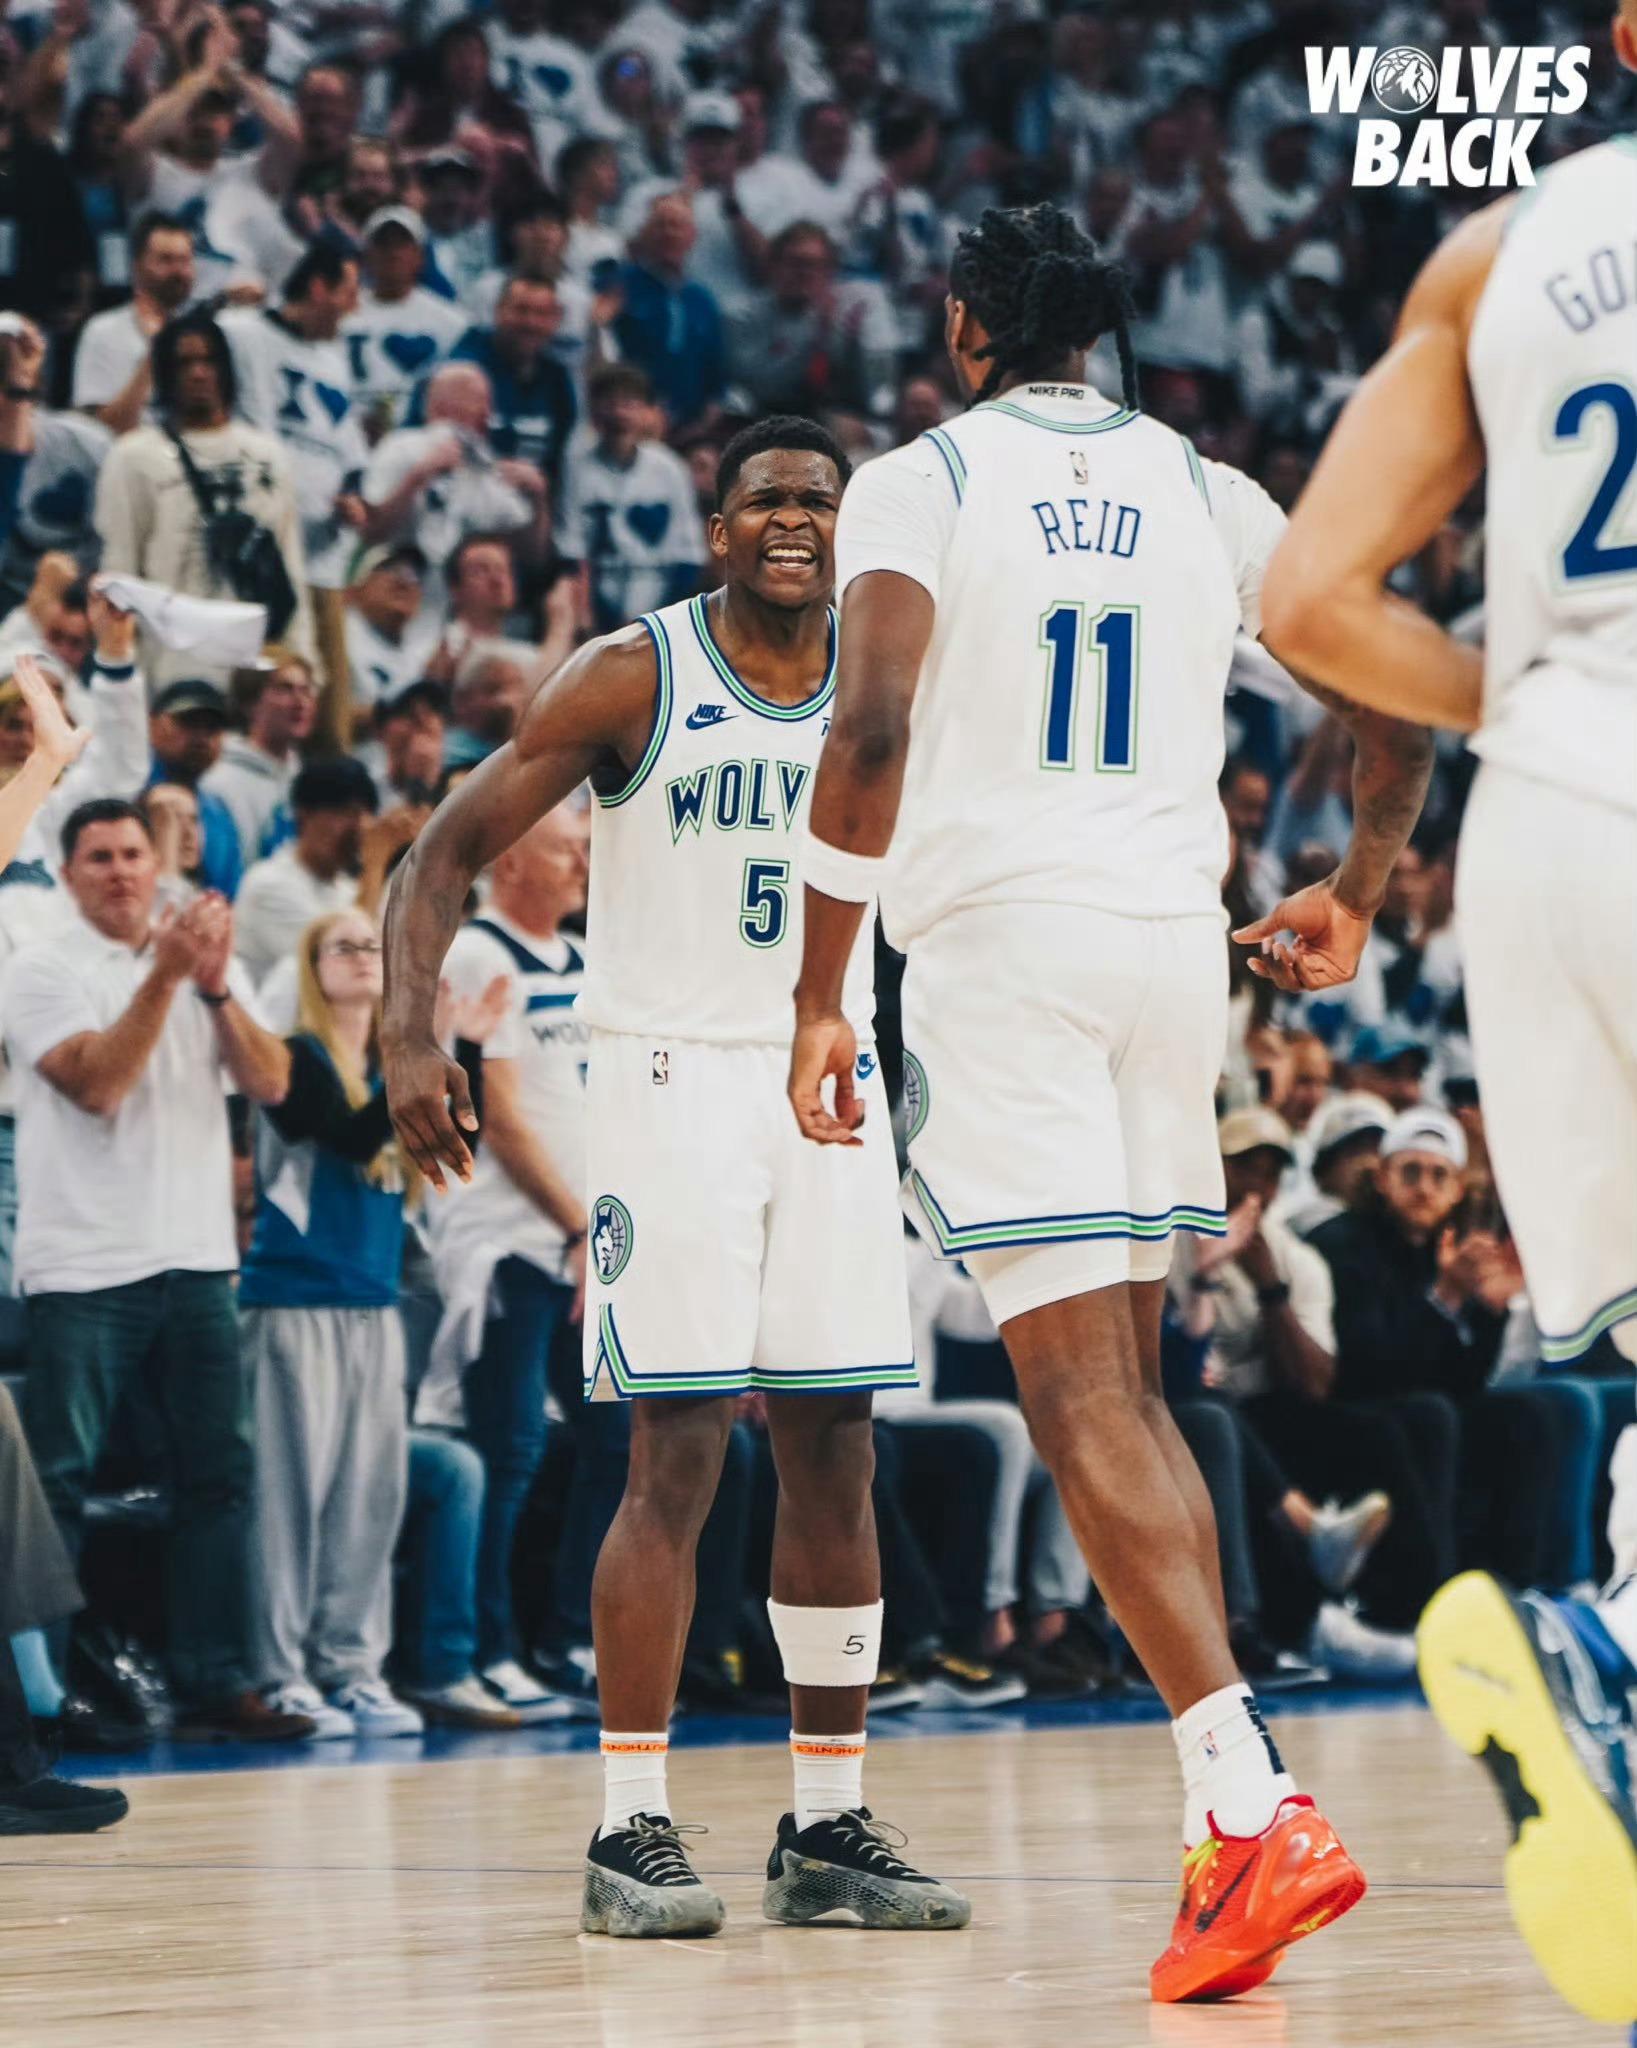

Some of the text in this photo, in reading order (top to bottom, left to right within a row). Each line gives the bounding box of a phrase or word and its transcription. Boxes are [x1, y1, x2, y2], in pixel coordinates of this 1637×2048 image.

[1545, 240, 1637, 333] GO
[1028, 386, 1085, 400] NIKE PRO
[1031, 499, 1141, 558] REID
[693, 703, 728, 720] NIKE
[1038, 600, 1141, 774] 11
[665, 758, 811, 847] WOLV
[739, 858, 790, 948] 5
[841, 1634, 867, 1655] 5
